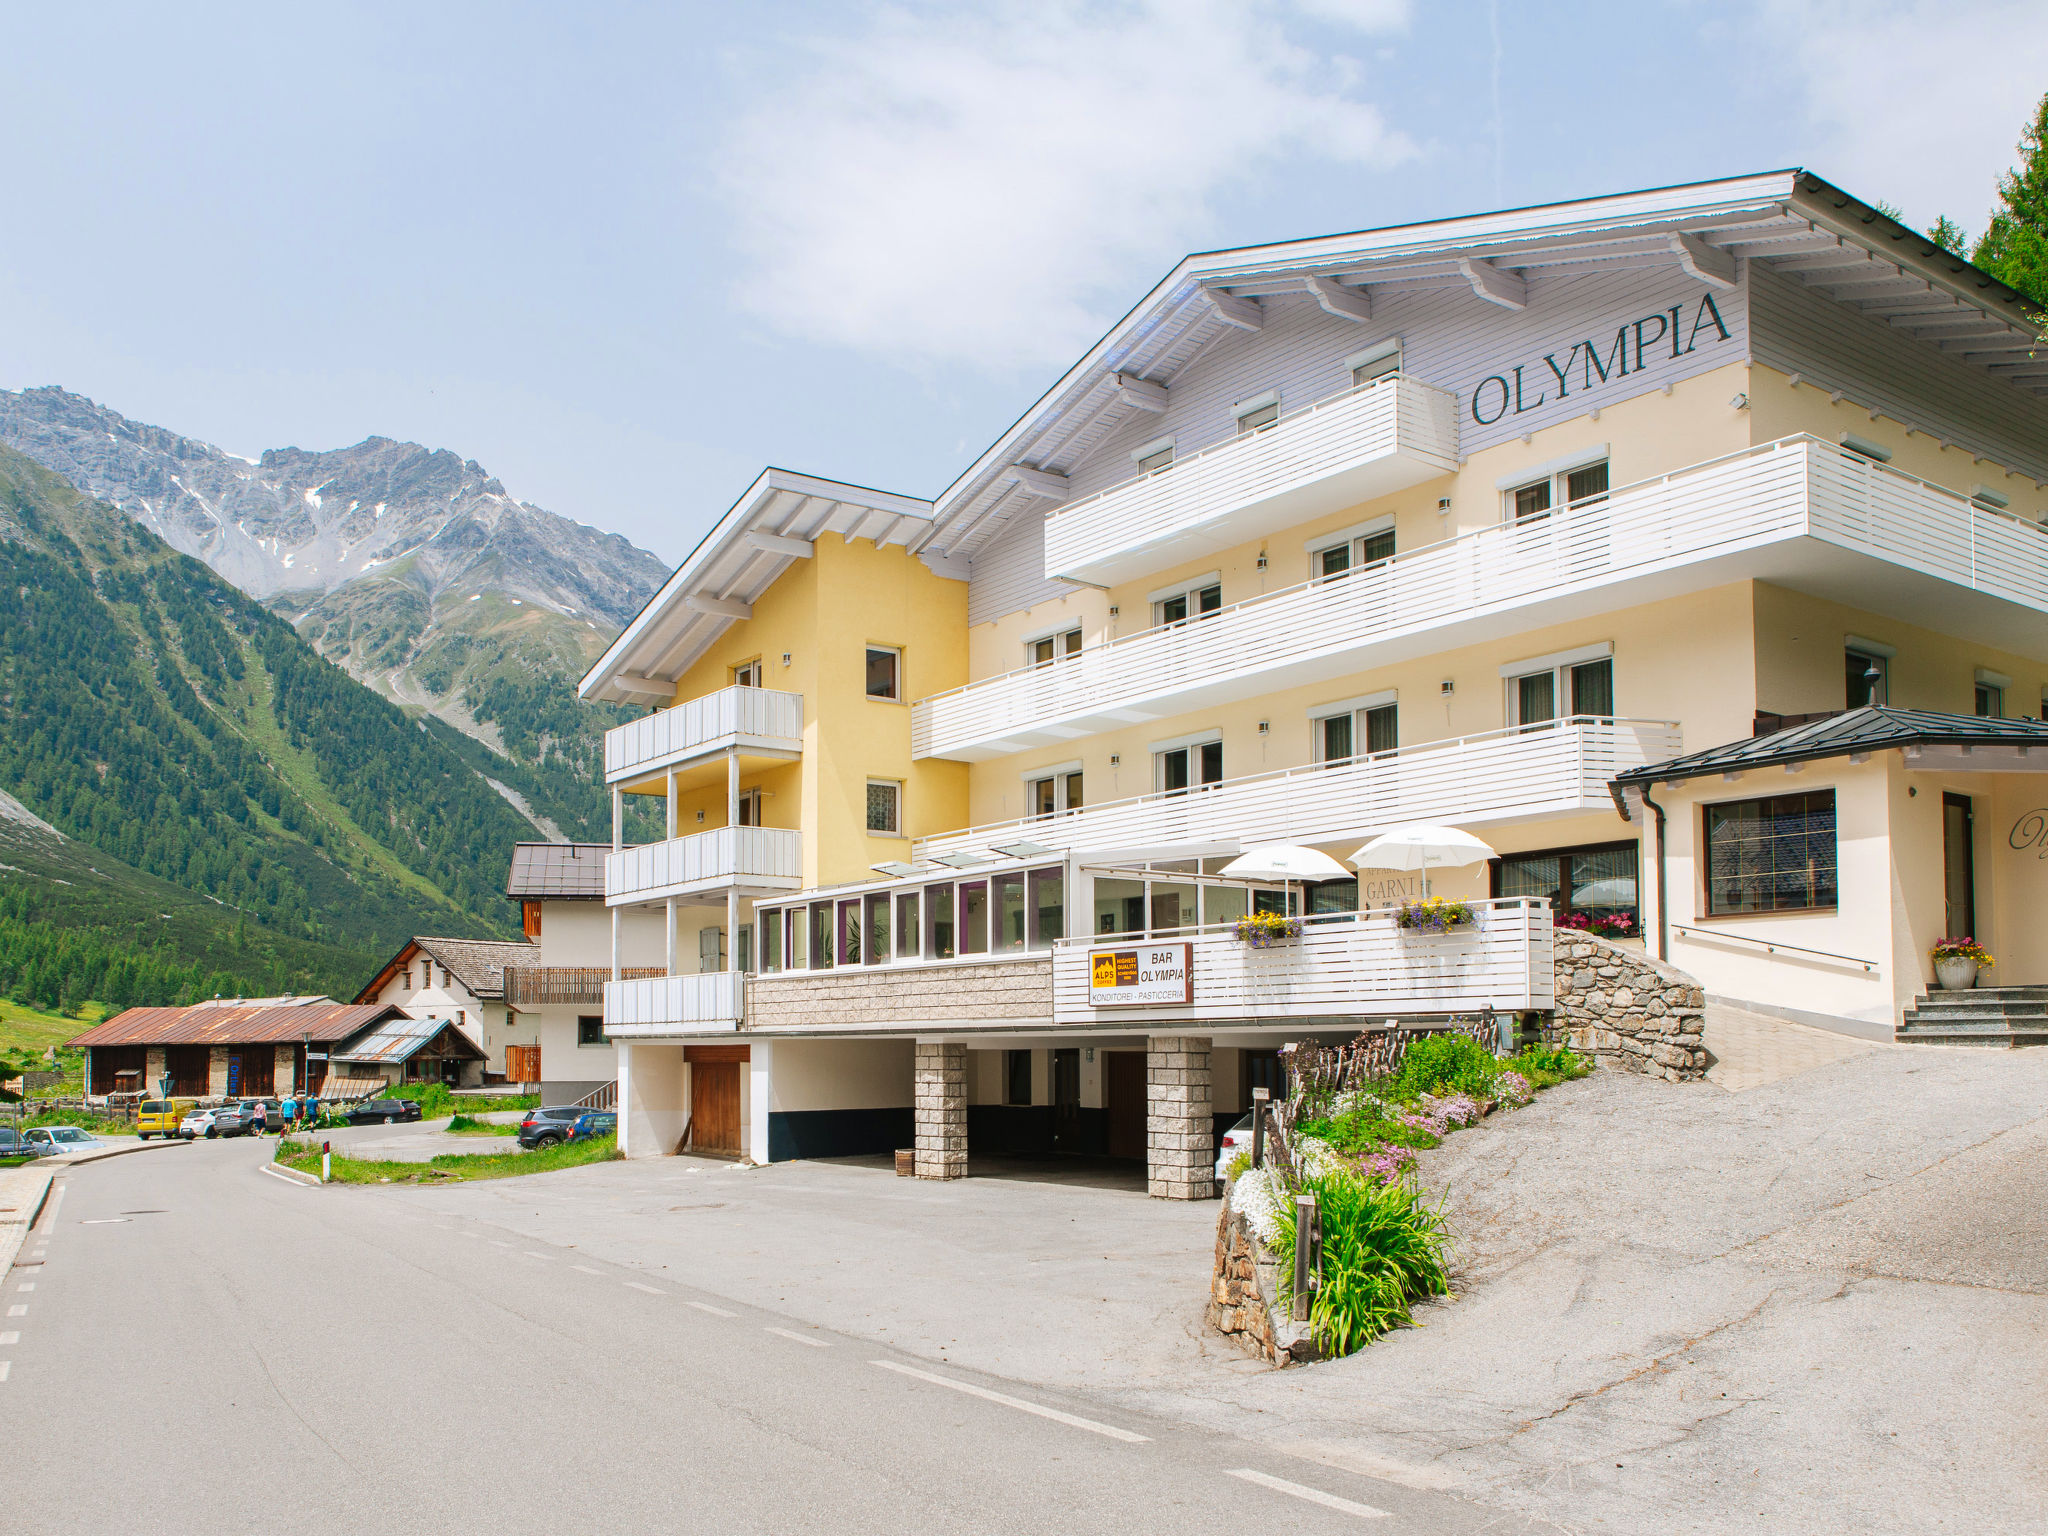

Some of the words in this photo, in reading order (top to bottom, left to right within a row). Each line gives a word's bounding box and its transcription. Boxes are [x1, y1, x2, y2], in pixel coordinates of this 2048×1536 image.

[1471, 292, 1732, 426] OLYMPIA
[1366, 877, 1416, 900] GARNI
[1151, 952, 1173, 965] BAR
[1095, 971, 1114, 980] ALPS
[1140, 969, 1184, 982] OLYMPIA
[1092, 992, 1134, 1003] KONDITOREI
[1138, 990, 1184, 1000] PASTICCERIA
